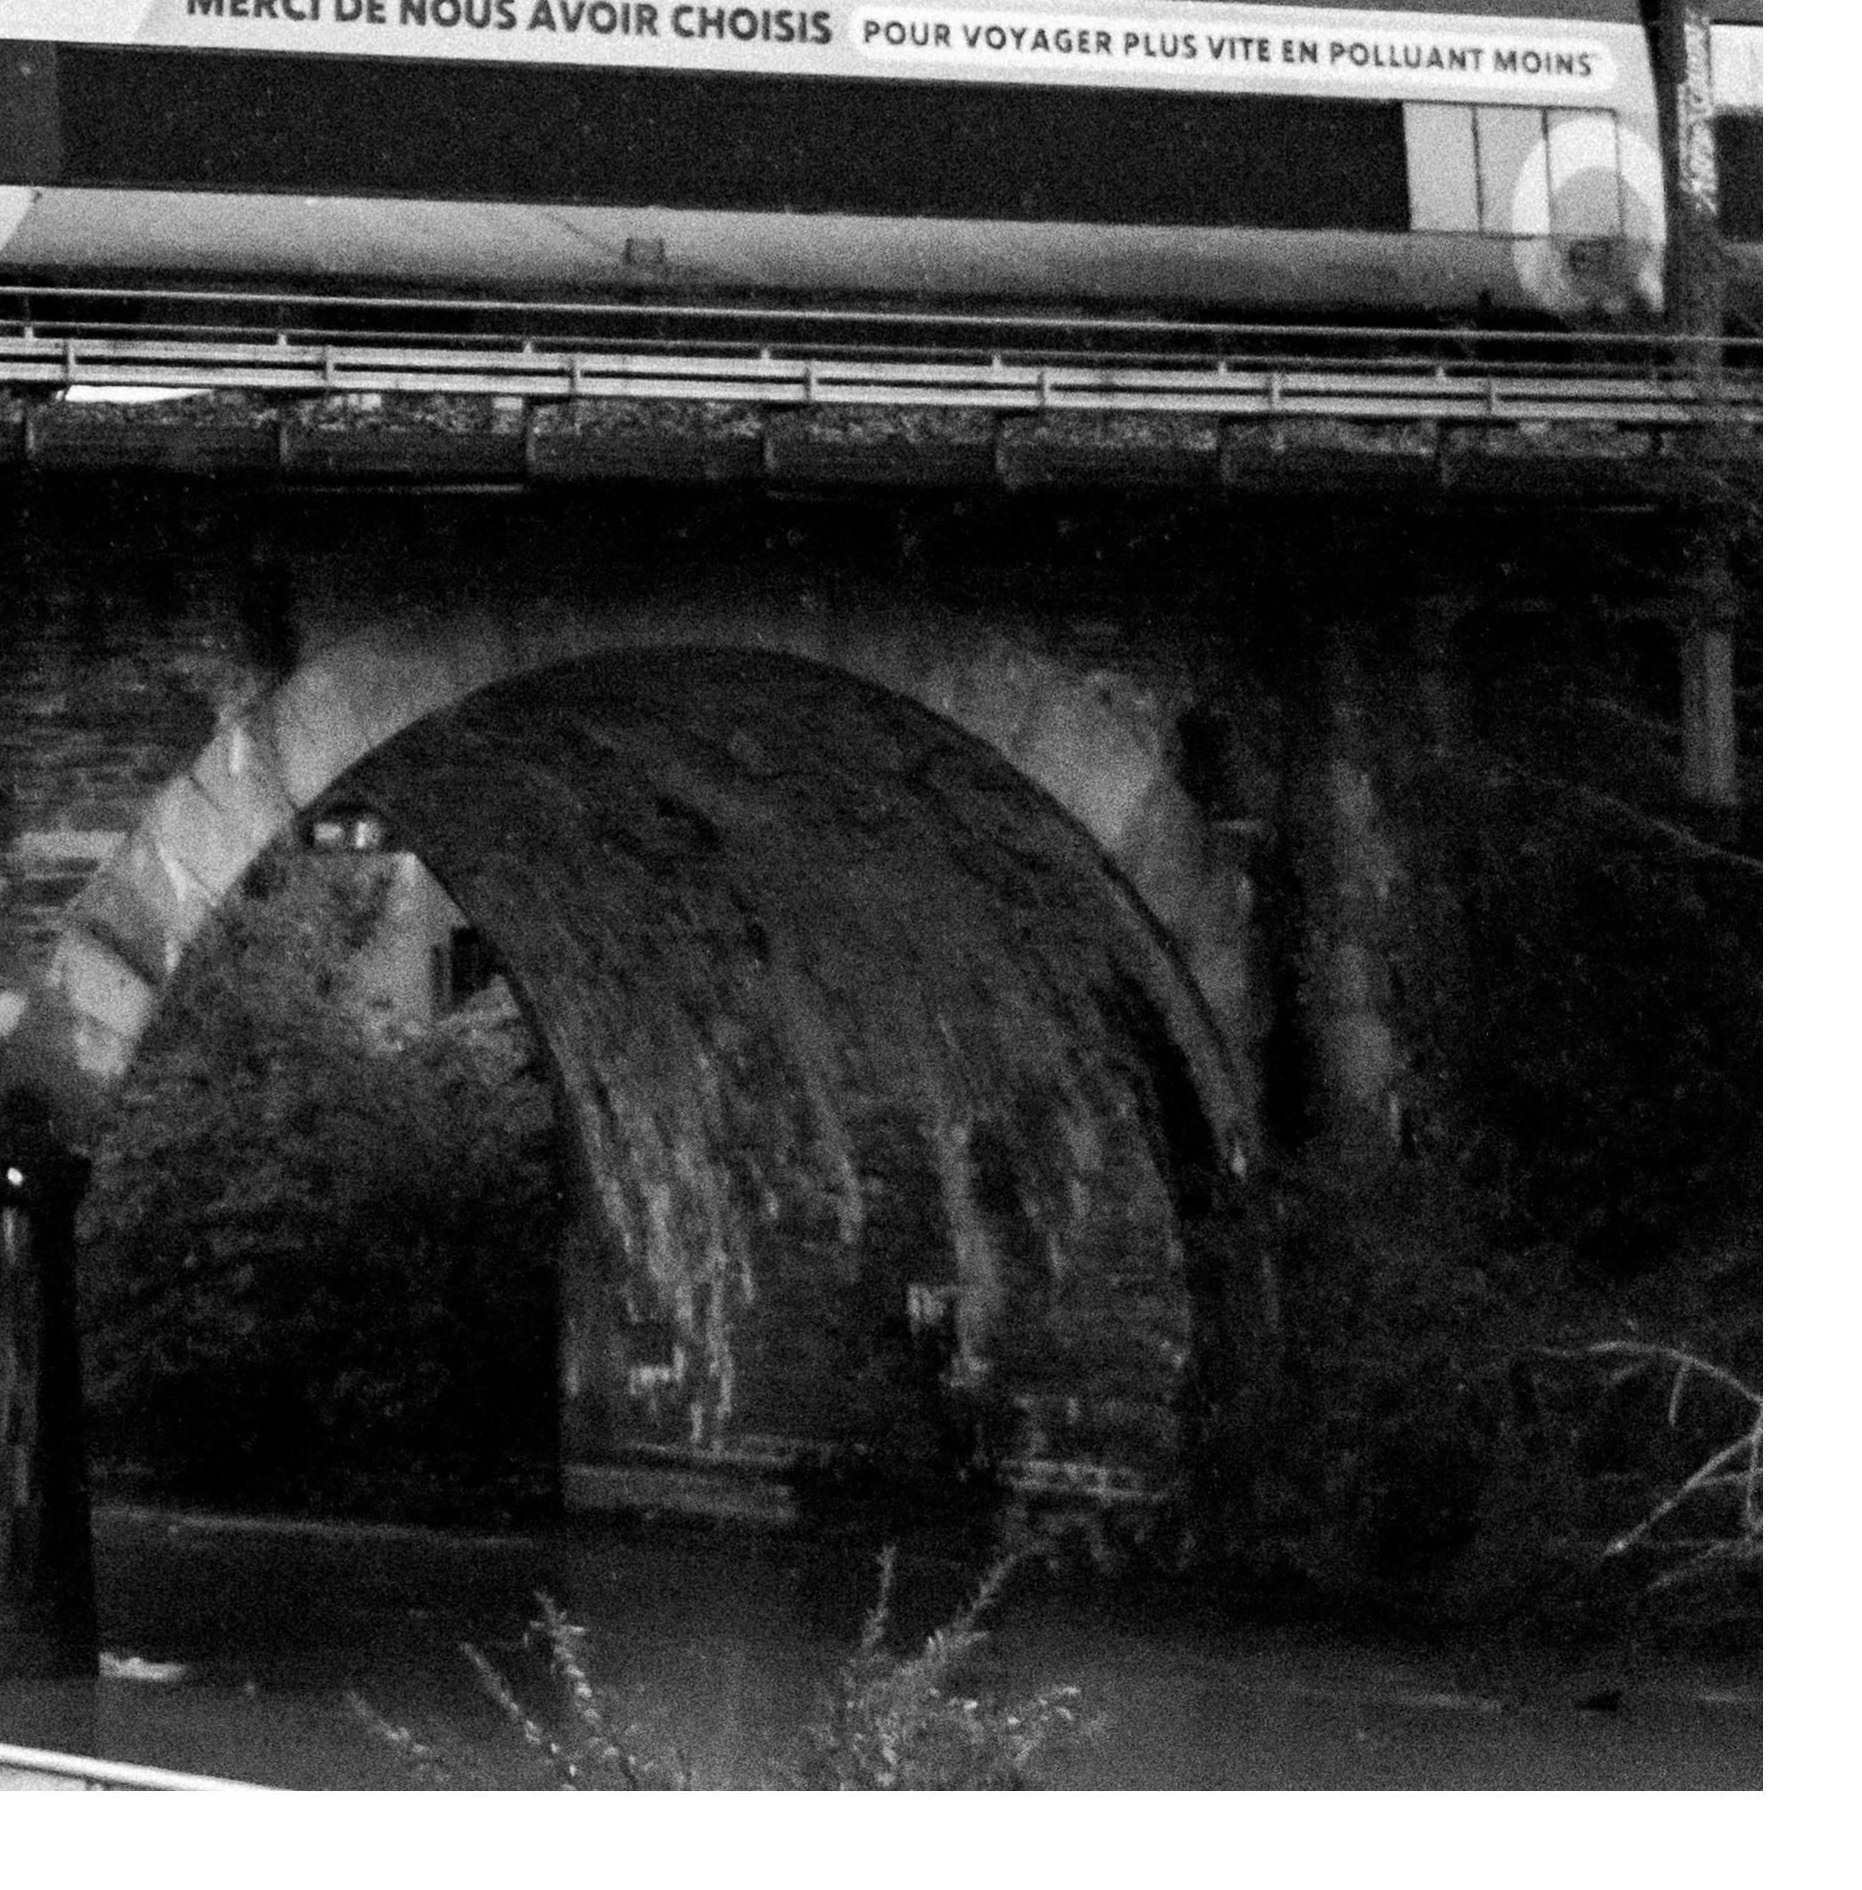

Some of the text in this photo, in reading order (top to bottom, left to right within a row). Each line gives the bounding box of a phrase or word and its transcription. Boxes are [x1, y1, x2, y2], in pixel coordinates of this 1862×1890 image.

[670, 4, 833, 45] CHOISIS
[864, 19, 1593, 78] POUR VOYAGER PLUS VITE EN POLLUANT MOINS
